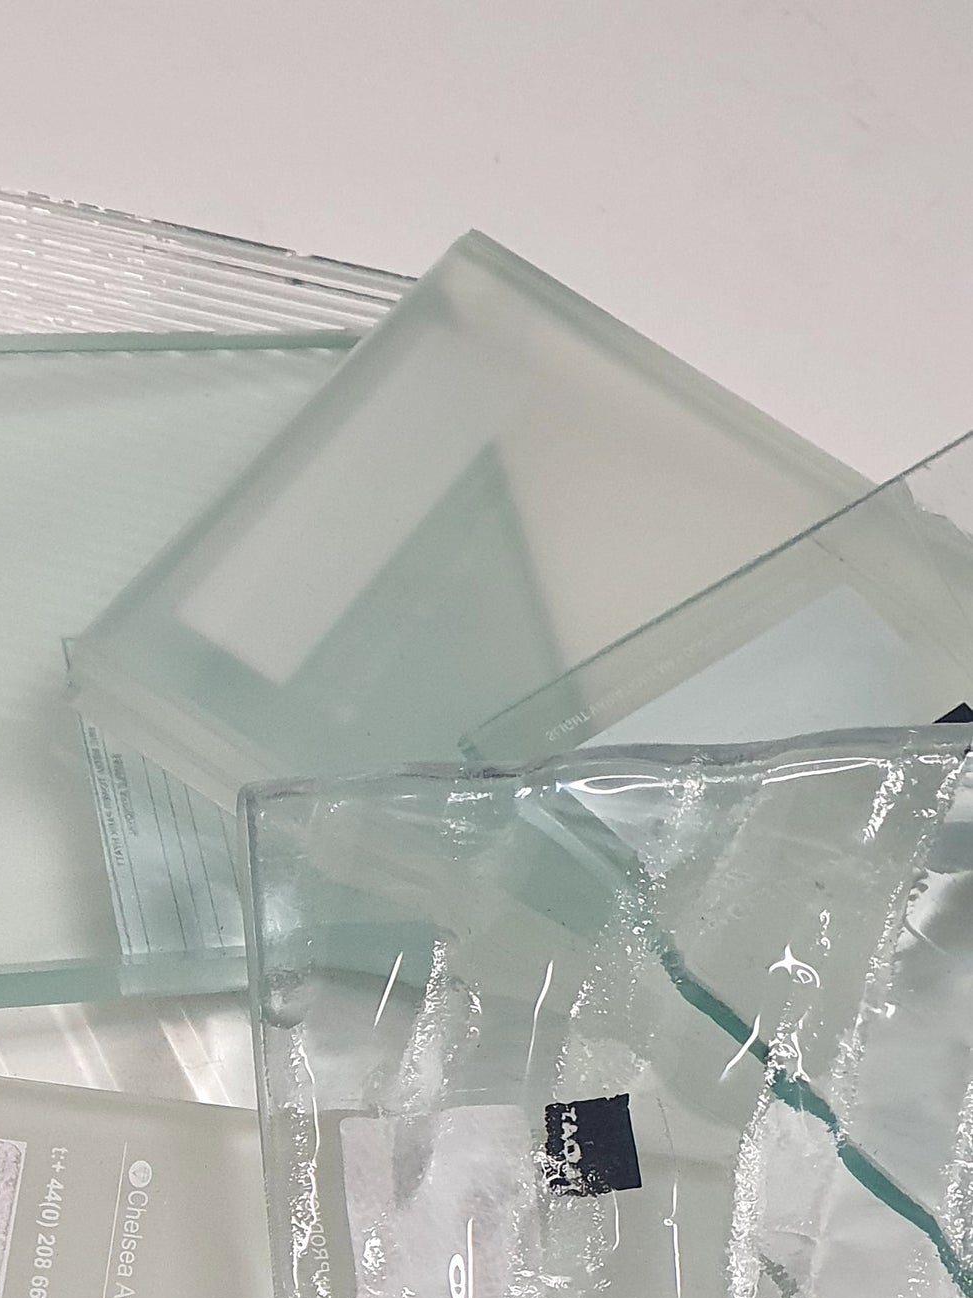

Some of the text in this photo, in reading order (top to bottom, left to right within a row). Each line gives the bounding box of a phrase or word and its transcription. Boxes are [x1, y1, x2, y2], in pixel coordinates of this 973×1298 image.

[36, 1178, 65, 1228] 44(0)
[33, 1233, 56, 1269] 208
[116, 1190, 149, 1278] Chelsea
